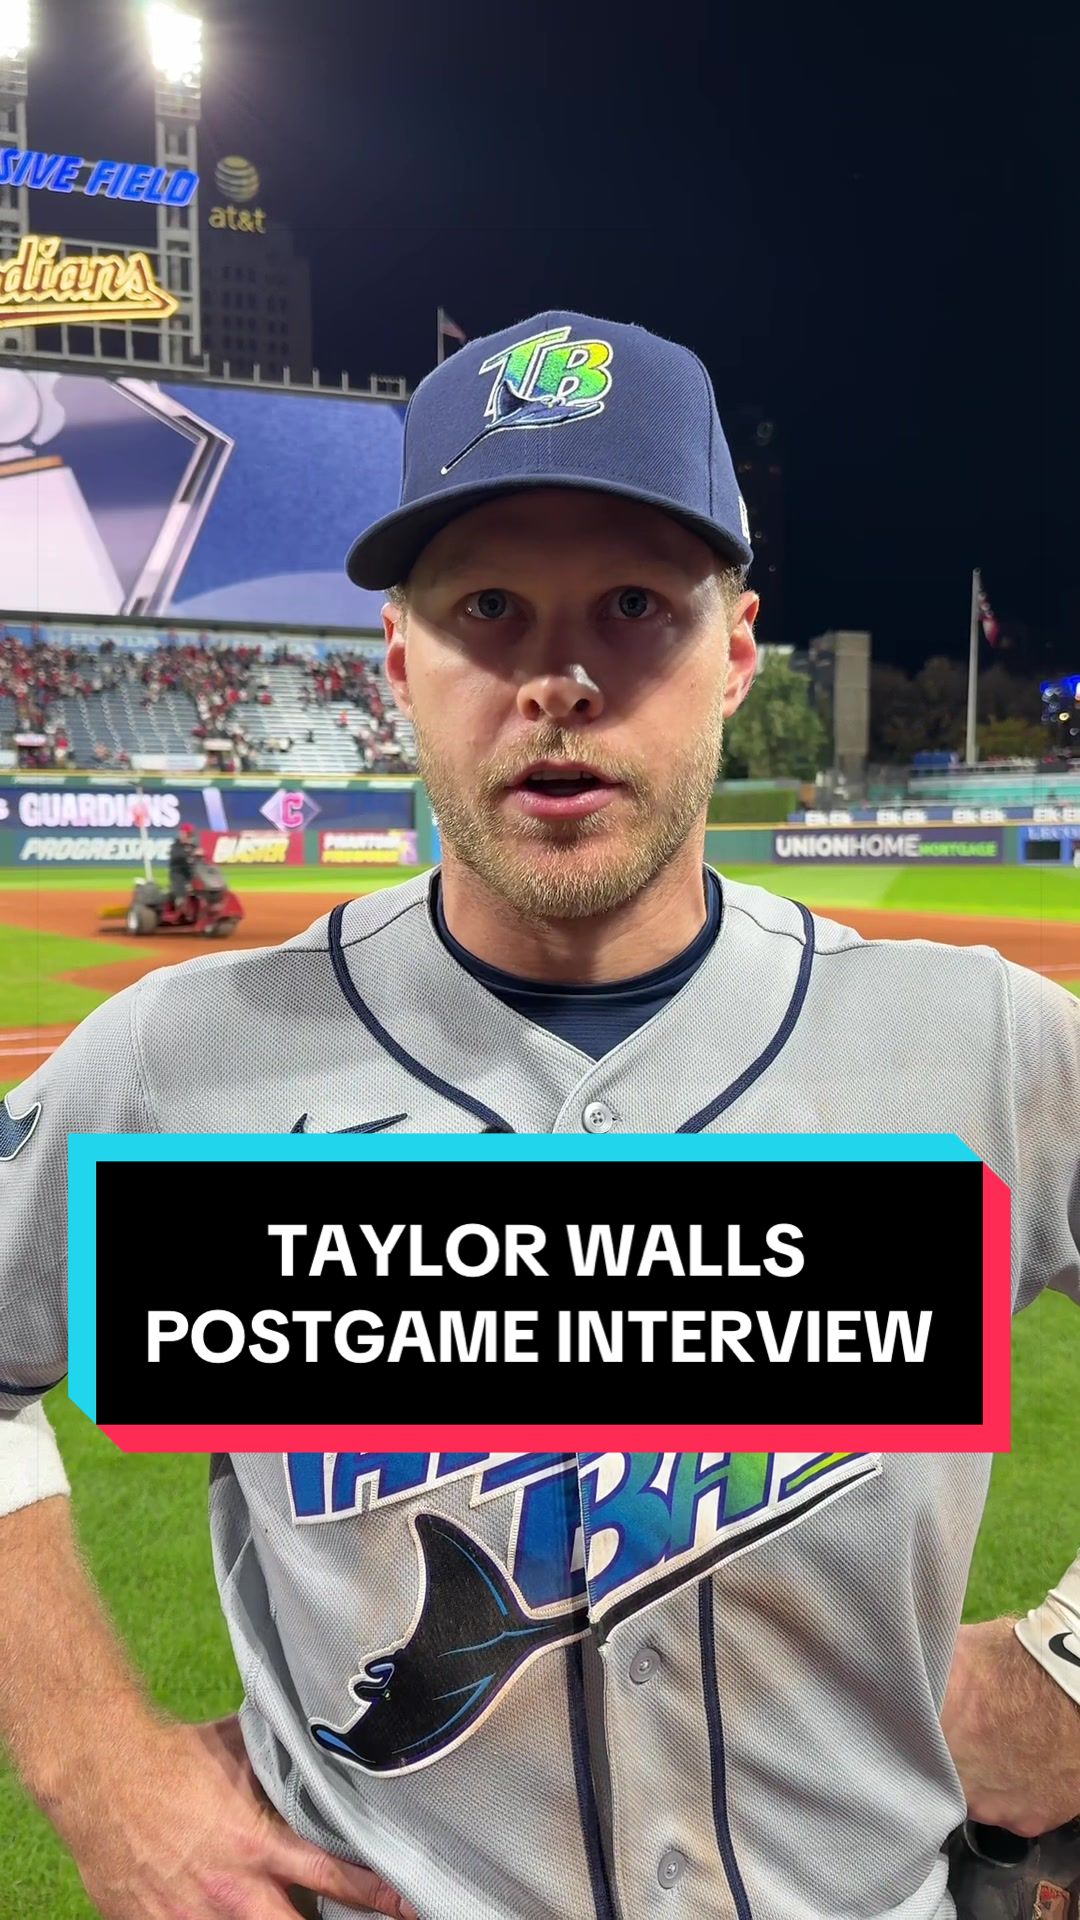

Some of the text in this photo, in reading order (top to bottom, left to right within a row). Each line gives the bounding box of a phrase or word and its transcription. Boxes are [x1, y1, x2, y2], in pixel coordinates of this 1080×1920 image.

[84, 160, 199, 207] FIELD
[208, 205, 266, 234] at&t
[479, 326, 613, 416] TB
[19, 792, 180, 828] GUARDIANS
[281, 791, 304, 828] C
